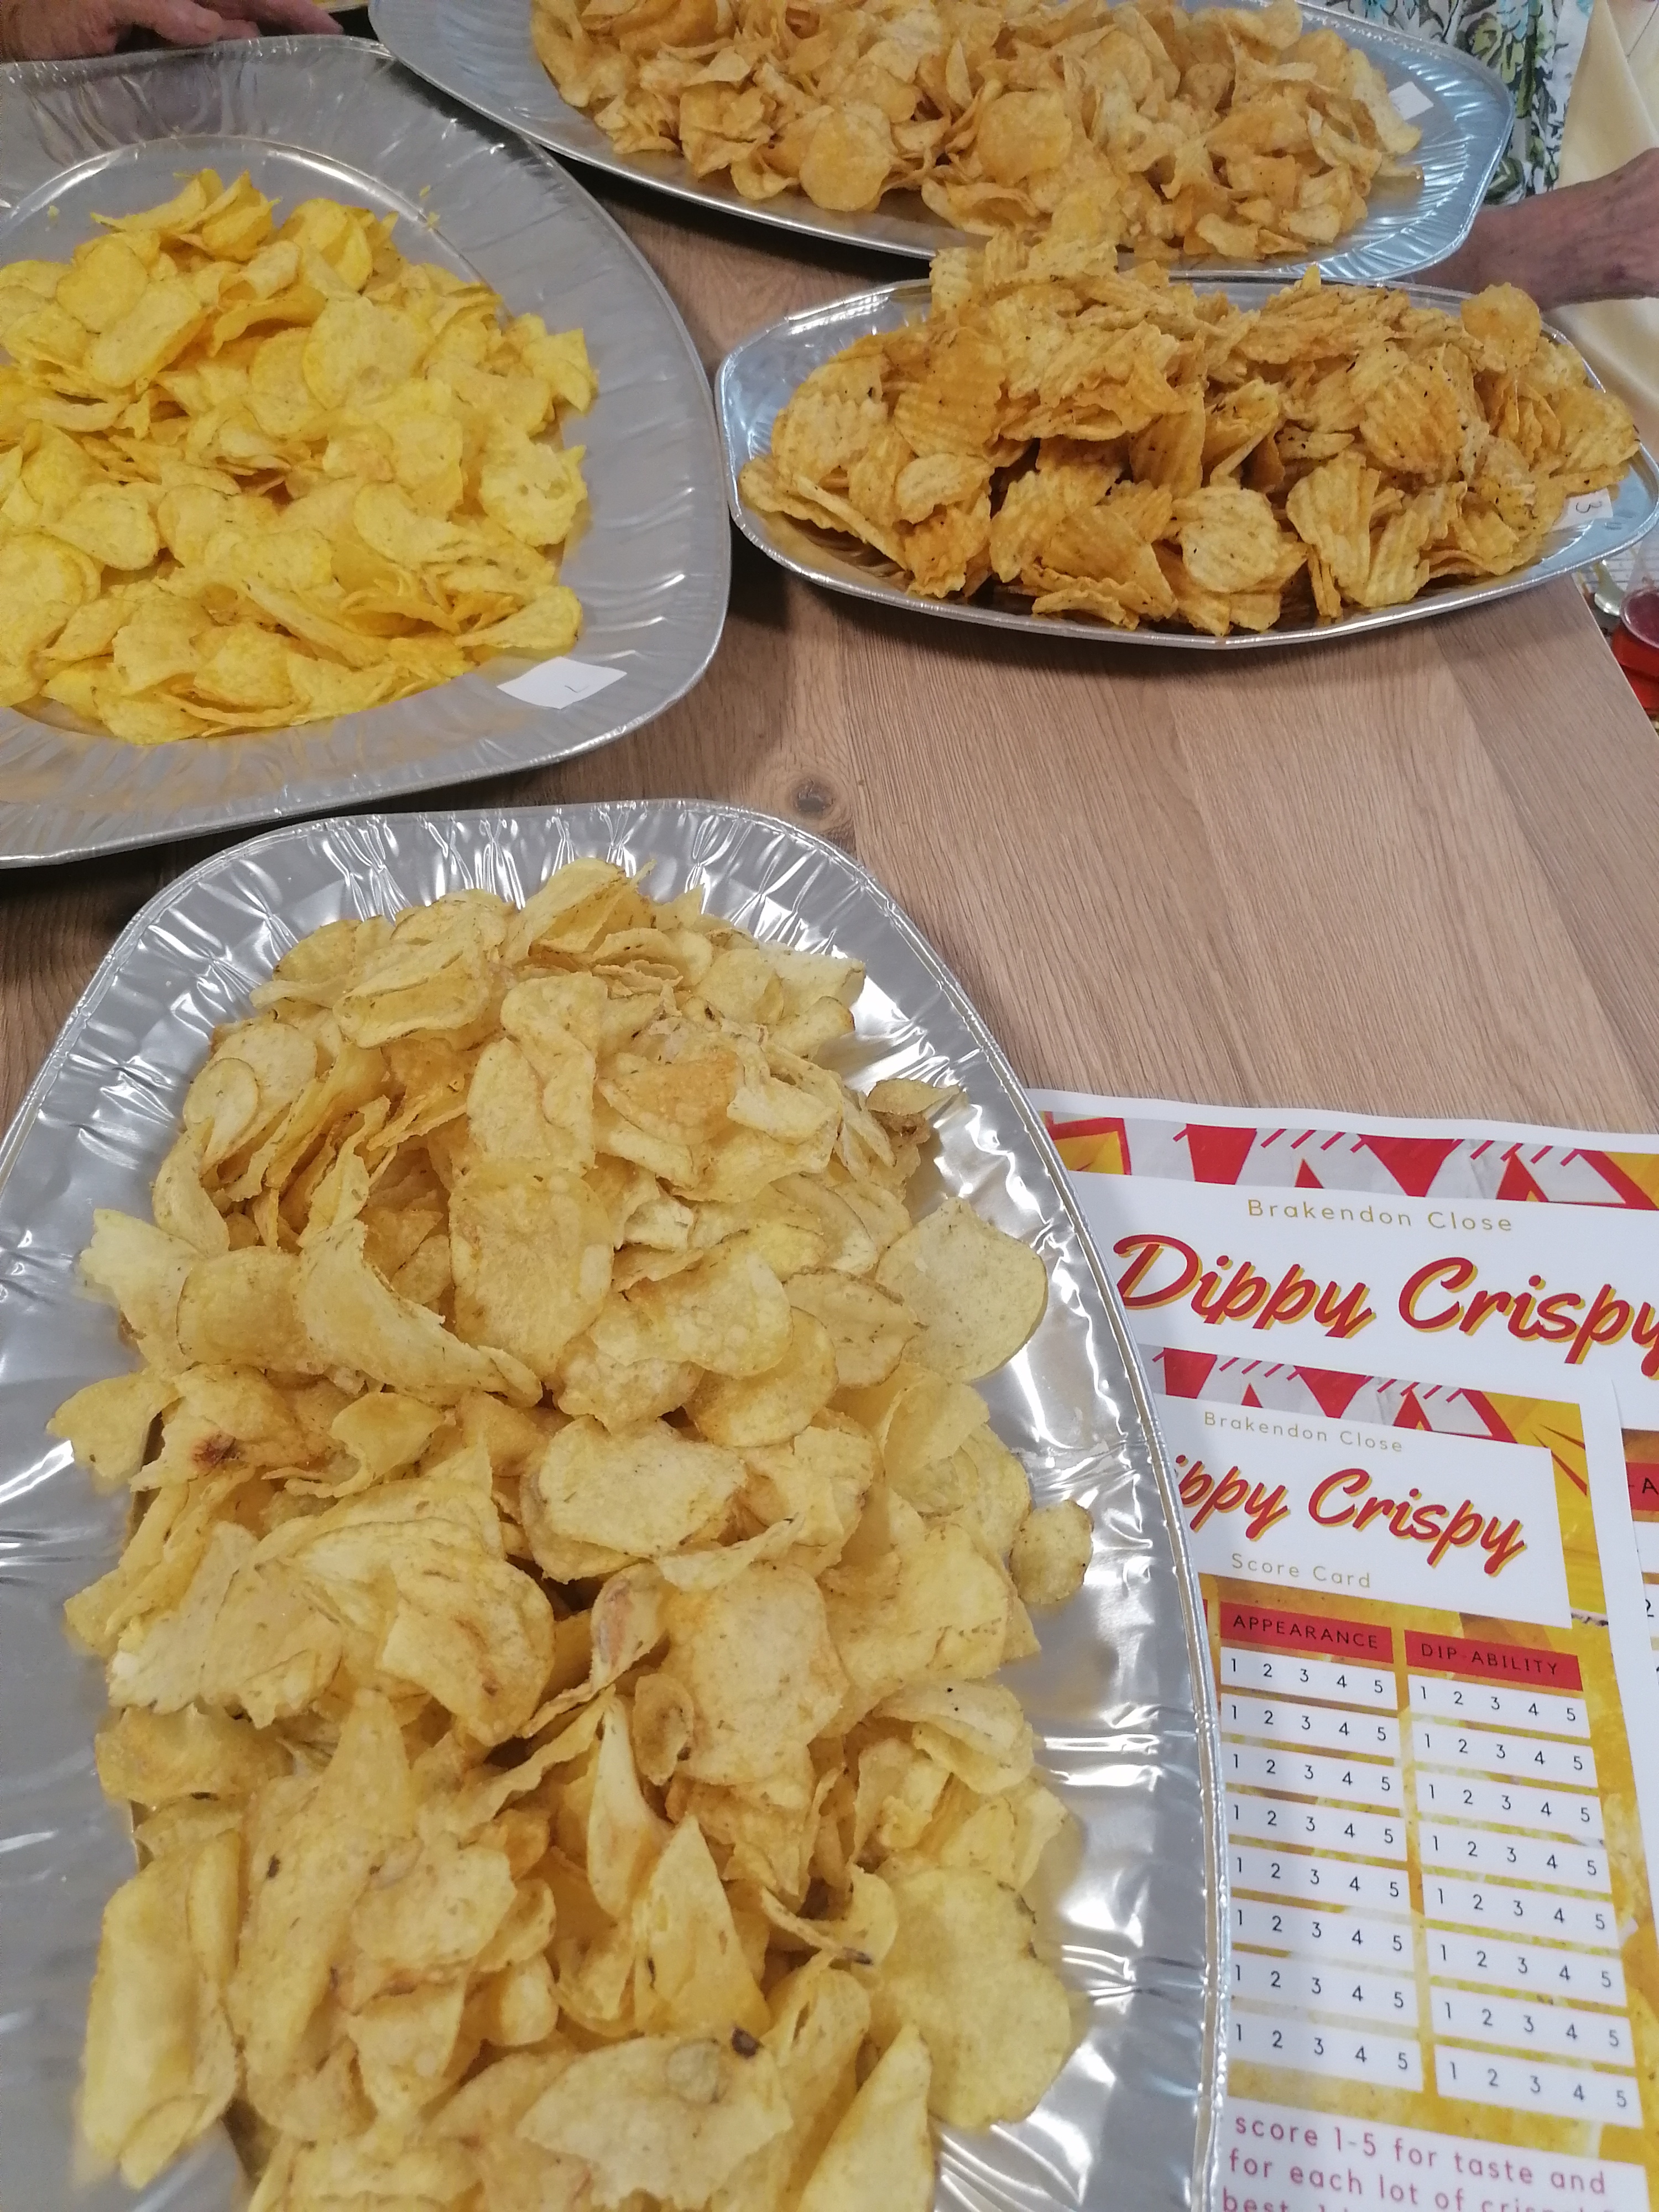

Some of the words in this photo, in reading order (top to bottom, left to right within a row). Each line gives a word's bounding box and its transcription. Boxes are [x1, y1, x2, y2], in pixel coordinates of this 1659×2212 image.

[1248, 1199, 1411, 1227] Brakendon
[1427, 1212, 1511, 1232] Close
[1114, 1234, 1376, 1338] Dippy
[1205, 1411, 1327, 1441] Brakendon
[1340, 1431, 1402, 1452] Close
[1308, 1469, 1526, 1575] Crispy
[1232, 1553, 1299, 1578] Score
[1313, 1566, 1370, 1588] Card
[1233, 1615, 1377, 1648] APPEARANCE
[1231, 1657, 1237, 1673] 1
[1262, 1662, 1273, 1678] 2
[1299, 1668, 1309, 1683] 3
[1335, 1674, 1348, 1689] 4
[1374, 1679, 1384, 1694] 5
[1231, 1704, 1237, 1720] 1
[1264, 1709, 1274, 1725] 2
[1301, 1714, 1311, 1731] 3
[1338, 1721, 1350, 1736] 4
[1376, 1726, 1386, 1742] 5
[1420, 1686, 1427, 1700] 1
[1453, 1691, 1464, 1705] 2
[1490, 1695, 1500, 1711] 3
[1527, 1702, 1540, 1717] 4
[1566, 1707, 1576, 1722] 5
[1233, 1753, 1238, 1770] 1
[1266, 1758, 1276, 1775] 2
[1304, 1764, 1314, 1780] 3
[1342, 1771, 1353, 1786] 4
[1381, 1776, 1391, 1792] 5
[1425, 1733, 1431, 1749] 1
[1458, 1738, 1469, 1754] 2
[1496, 1744, 1506, 1759] 3
[1534, 1750, 1546, 1765] 4
[1573, 1755, 1583, 1771] 5
[1233, 1803, 1239, 1820] 1
[1267, 1809, 1277, 1828] 2
[1305, 1815, 1316, 1832] 3
[1343, 1822, 1356, 1839] 4
[1384, 1827, 1394, 1844] 5
[1428, 1783, 1434, 1799] 1
[1463, 1789, 1474, 1806] 2
[1501, 1794, 1511, 1811] 3
[1540, 1801, 1552, 1817] 4
[1580, 1807, 1590, 1823] 5
[1432, 1835, 1438, 1851] 1
[1467, 1840, 1478, 1858] 2
[1506, 1846, 1517, 1864] 3
[1546, 1854, 1558, 1870] 4
[1587, 1859, 1597, 1876] 5
[1237, 1856, 1243, 1874] 1
[1270, 1862, 1281, 1880] 2
[1310, 1868, 1320, 1886] 3
[1349, 1875, 1361, 1892] 4
[1389, 1881, 1399, 1898] 5
[1437, 1887, 1443, 1905] 1
[1473, 1893, 1484, 1911] 2
[1513, 1900, 1524, 1917] 3
[1553, 1907, 1566, 1924] 4
[1595, 1913, 1605, 1931] 5
[1237, 1908, 1243, 1926] 1
[1271, 1915, 1282, 1933] 2
[1311, 1921, 1322, 1939] 3
[1351, 1928, 1364, 1945] 4
[1392, 1934, 1403, 1952] 5
[1235, 1964, 1241, 1982] 1
[1270, 1970, 1281, 1989] 2
[1311, 1976, 1322, 1995] 3
[1352, 1985, 1364, 2002] 4
[1394, 1991, 1404, 2009] 5
[1441, 1943, 1447, 1961] 1
[1476, 1949, 1488, 1968] 2
[1517, 1957, 1528, 1975] 3
[1558, 1964, 1571, 1981] 4
[1601, 1970, 1611, 1989] 5
[1444, 2001, 1452, 2020] 1
[1481, 2008, 1493, 2027] 2
[1523, 2015, 1535, 2034] 3
[1565, 2023, 1578, 2041] 4
[1609, 2029, 1620, 2048] 5
[1236, 2023, 1242, 2042] 1
[1272, 2030, 1284, 2049] 2
[1313, 2037, 1324, 2056] 3
[1354, 2045, 1368, 2063] 4
[1397, 2052, 1408, 2071] 5
[1450, 2061, 1457, 2080] 1
[1487, 2068, 1499, 2088] 2
[1530, 2075, 1541, 2094] 3
[1573, 2084, 1585, 2101] 4
[1616, 2090, 1627, 2109] 5
[1235, 2116, 1318, 2147] score
[1334, 2127, 1376, 2158] 1-5
[1394, 2137, 1437, 2167] for
[1454, 2152, 1533, 2184] taste
[1551, 2171, 1605, 2195] and
[1228, 2147, 1272, 2178] for
[1290, 2166, 1362, 2195] each
[1379, 2174, 1418, 2205] lot
[1434, 2188, 1464, 2212] of
